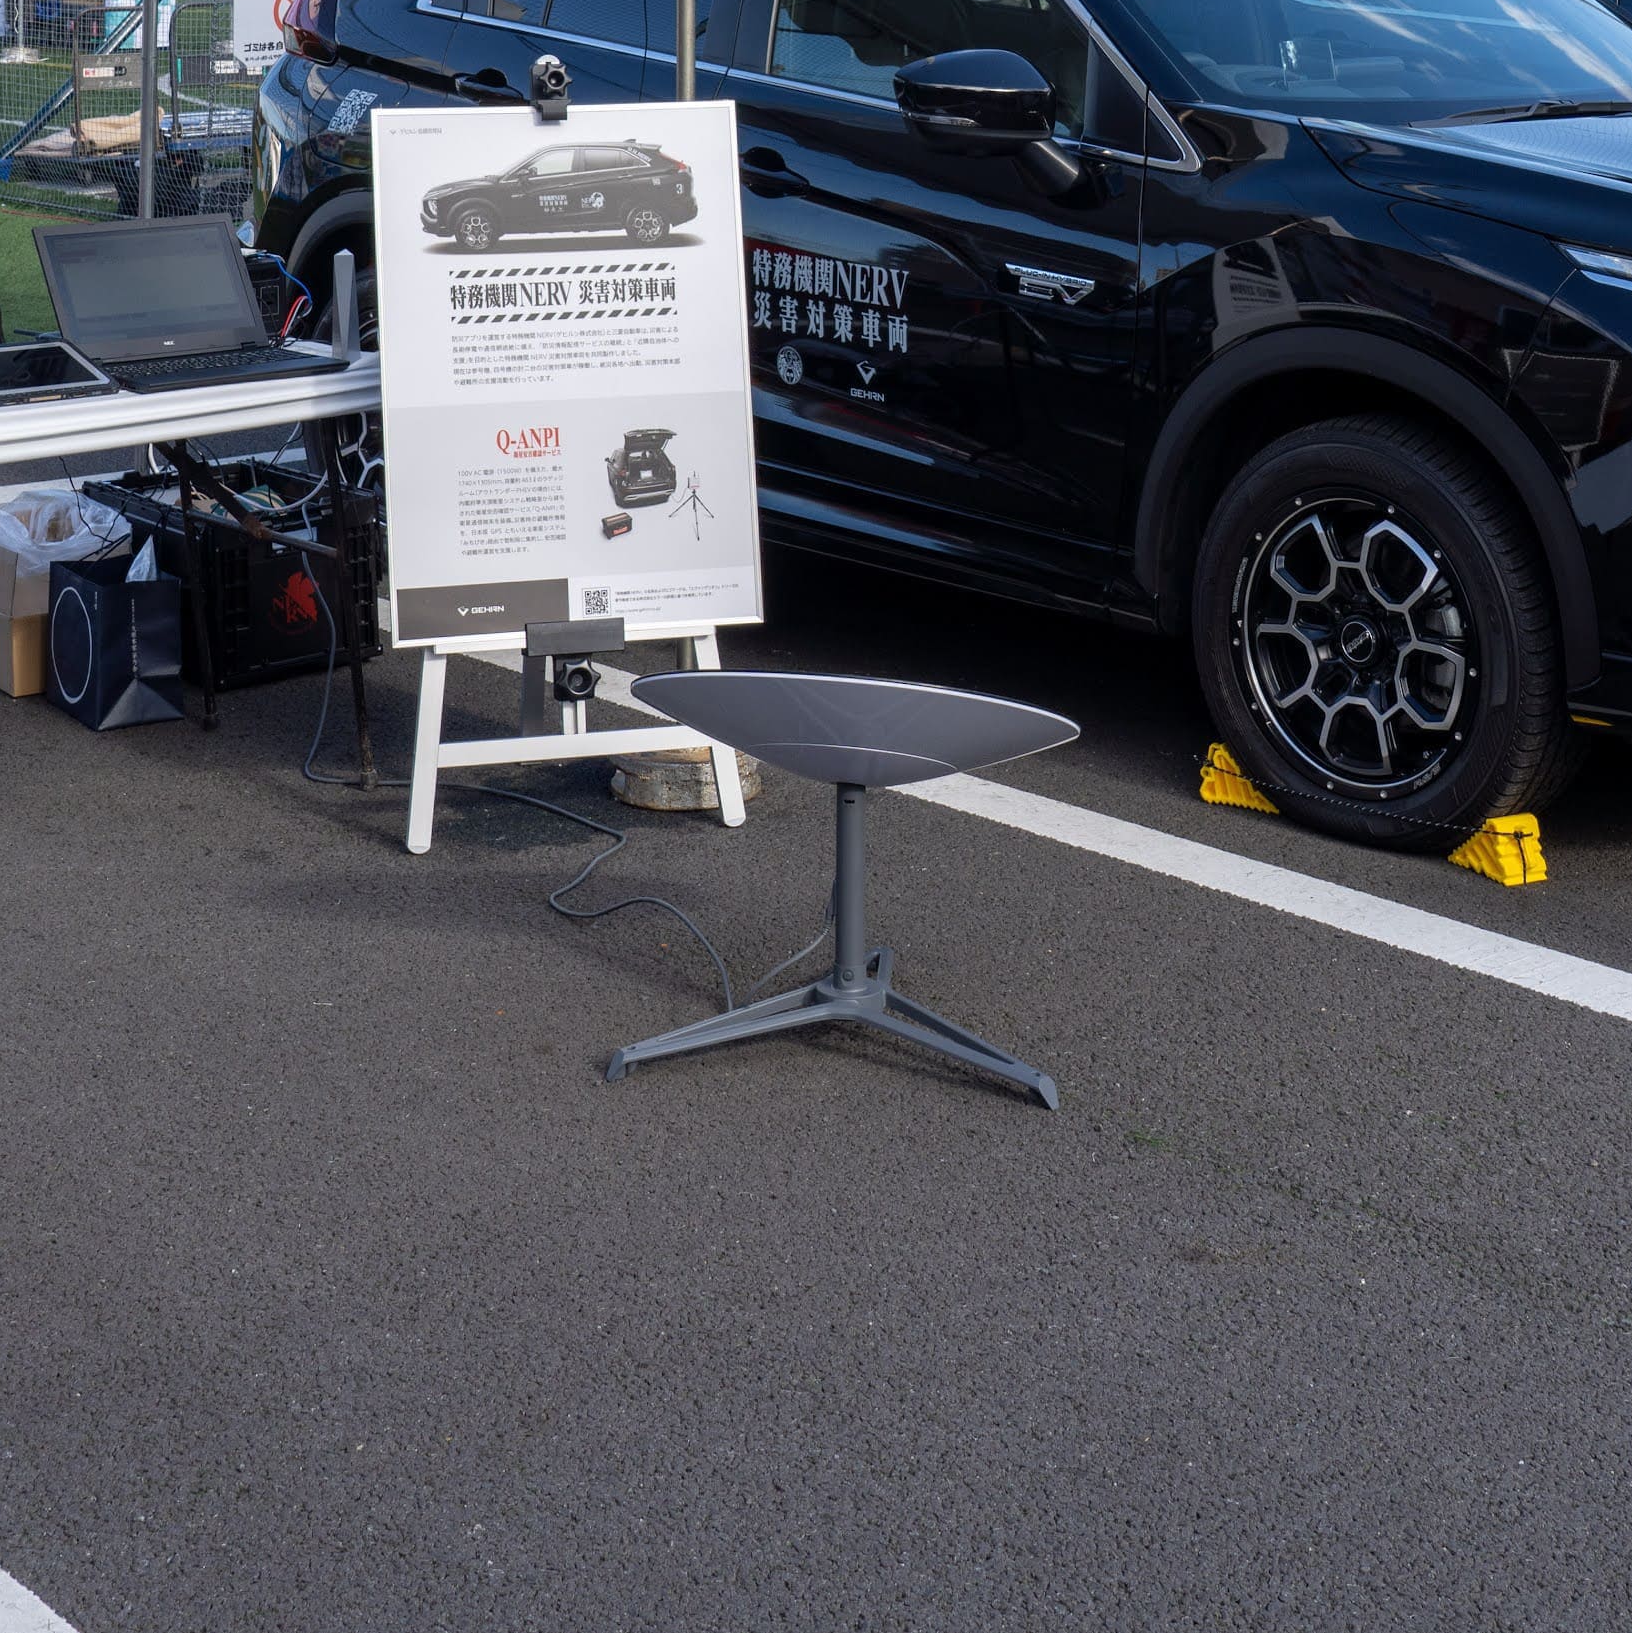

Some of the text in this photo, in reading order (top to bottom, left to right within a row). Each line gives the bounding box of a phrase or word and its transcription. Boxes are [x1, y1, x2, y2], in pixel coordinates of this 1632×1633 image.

[449, 276, 676, 310] 特務機関NERV 災害対策車両
[752, 247, 911, 310] 特務機関NERV
[753, 290, 908, 354] 災害対策車両
[850, 387, 885, 403] GEHIRN
[496, 426, 561, 455] Q-ANPI
